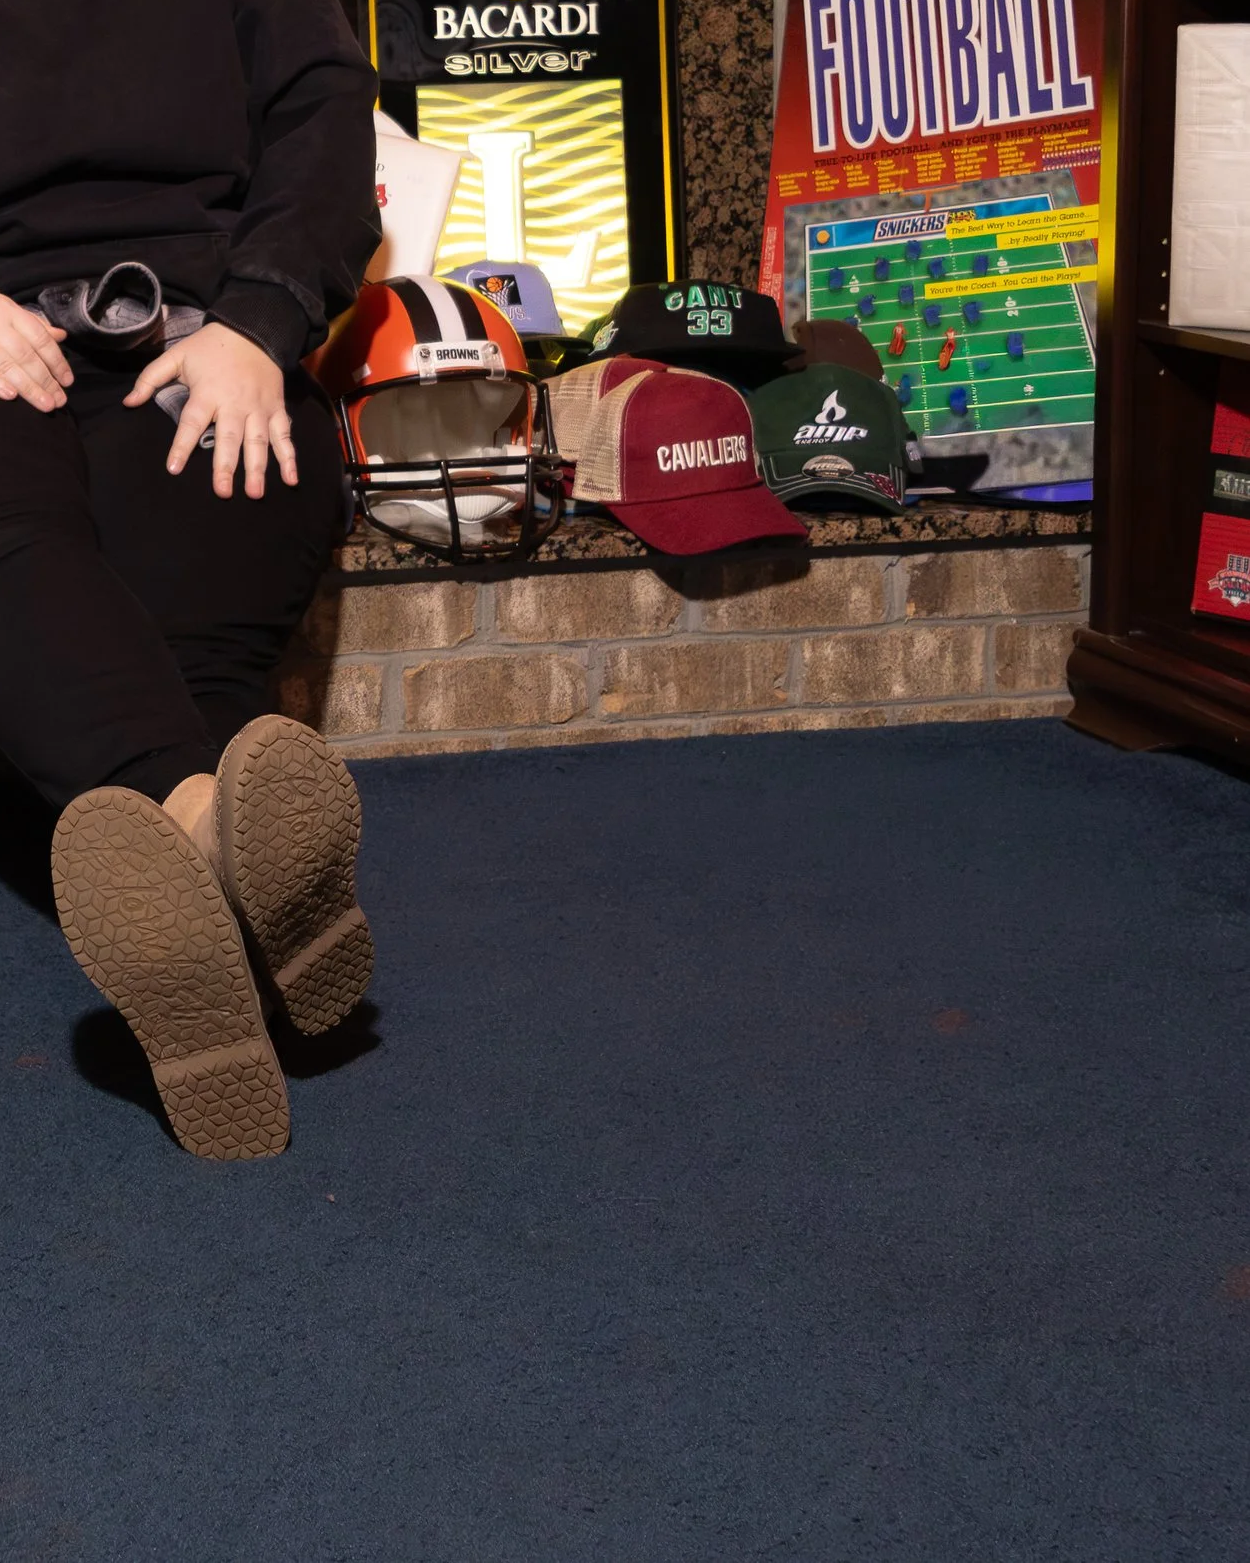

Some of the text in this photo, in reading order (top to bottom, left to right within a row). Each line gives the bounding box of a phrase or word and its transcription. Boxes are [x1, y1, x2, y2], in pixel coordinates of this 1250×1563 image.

[433, 3, 600, 40] BACARDI
[1005, 129, 1024, 139] THE
[878, 214, 946, 238] SNICKERS
[951, 227, 965, 235] The
[968, 225, 984, 233] Best
[987, 222, 1005, 230] Way
[1017, 218, 1041, 227] Learn
[1044, 215, 1057, 223] the
[1023, 233, 1049, 243] Really
[1052, 229, 1086, 239] Playing!
[930, 286, 954, 295] You're
[955, 284, 969, 292] the
[971, 281, 998, 290] Coach
[1021, 276, 1038, 285] Call
[1056, 272, 1081, 281] Plays!
[664, 284, 743, 311] GANT
[687, 309, 732, 336] 33
[436, 348, 480, 362] BROWNS
[657, 435, 747, 473] CAVALIERS
